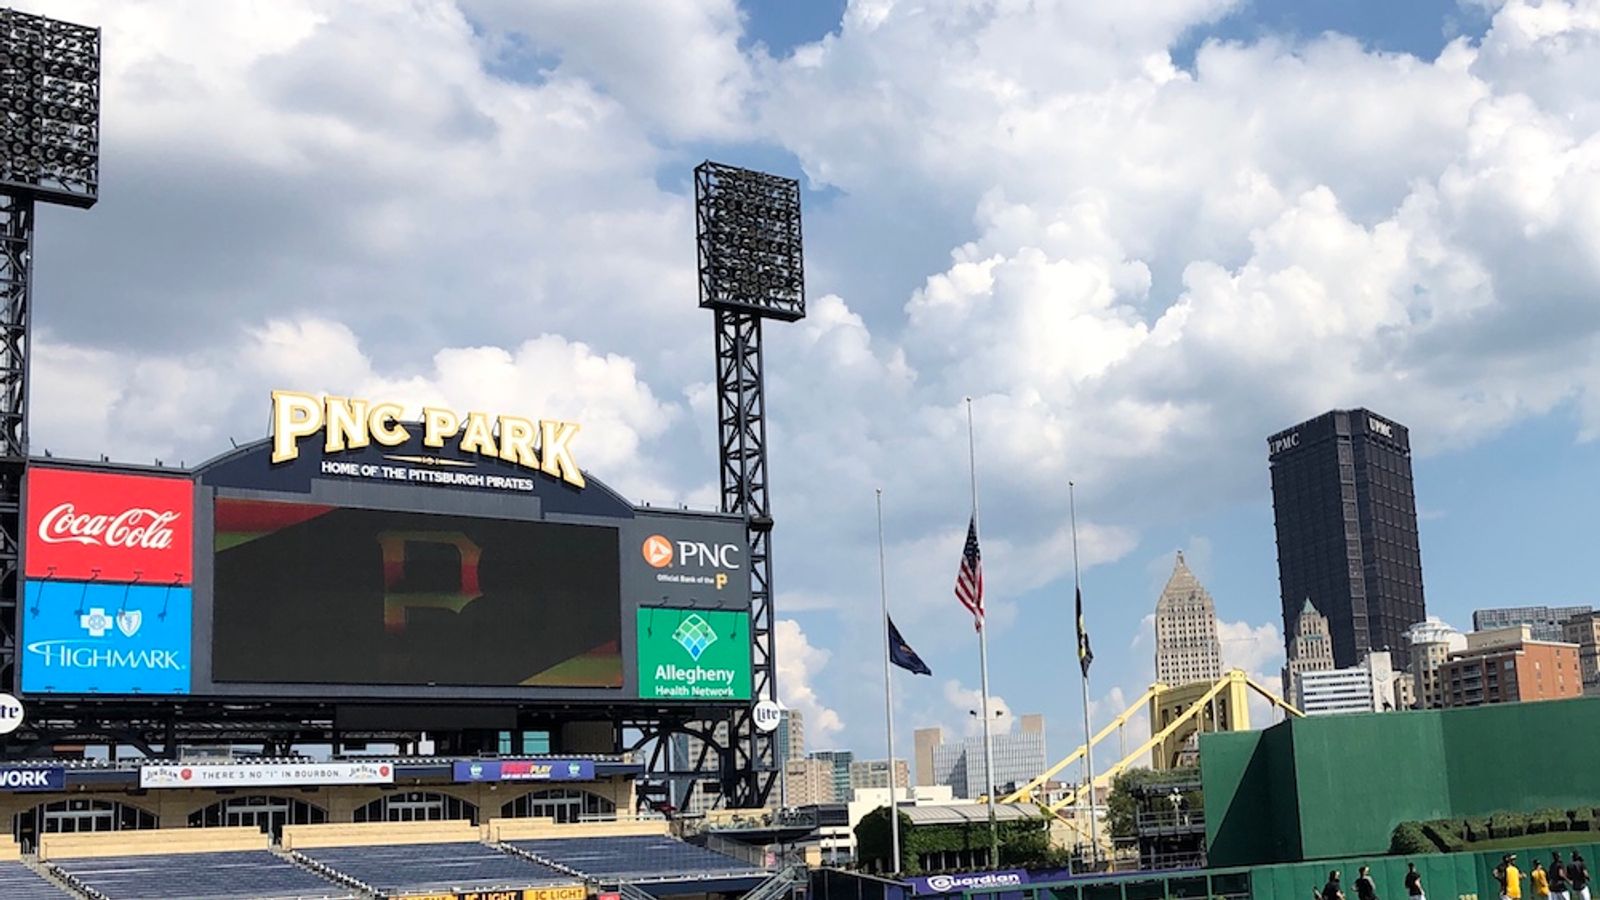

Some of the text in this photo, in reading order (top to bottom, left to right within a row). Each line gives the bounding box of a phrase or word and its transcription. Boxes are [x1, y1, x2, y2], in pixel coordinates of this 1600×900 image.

[1369, 417, 1393, 438] UPMC
[271, 389, 586, 488] PNC PARK
[1269, 433, 1300, 456] UPMC
[321, 461, 534, 491] HOME OF THE PITTSBURGH PIRATES
[38, 502, 181, 550] Coca-Cola
[676, 540, 740, 569] PNC
[657, 573, 680, 583] Official
[680, 574, 696, 583] Bank
[696, 575, 704, 584] of
[704, 575, 715, 584] the
[27, 639, 182, 670] HIGHMARK
[655, 664, 735, 685] Allegheny
[655, 685, 734, 697] Health Network
[0, 705, 19, 719] te
[756, 707, 778, 723] Lite
[202, 771, 245, 780] THERE'S
[249, 771, 262, 779] NO
[281, 770, 292, 778] IN
[927, 873, 1019, 892] Guardian
[551, 889, 583, 900] LIGHT
